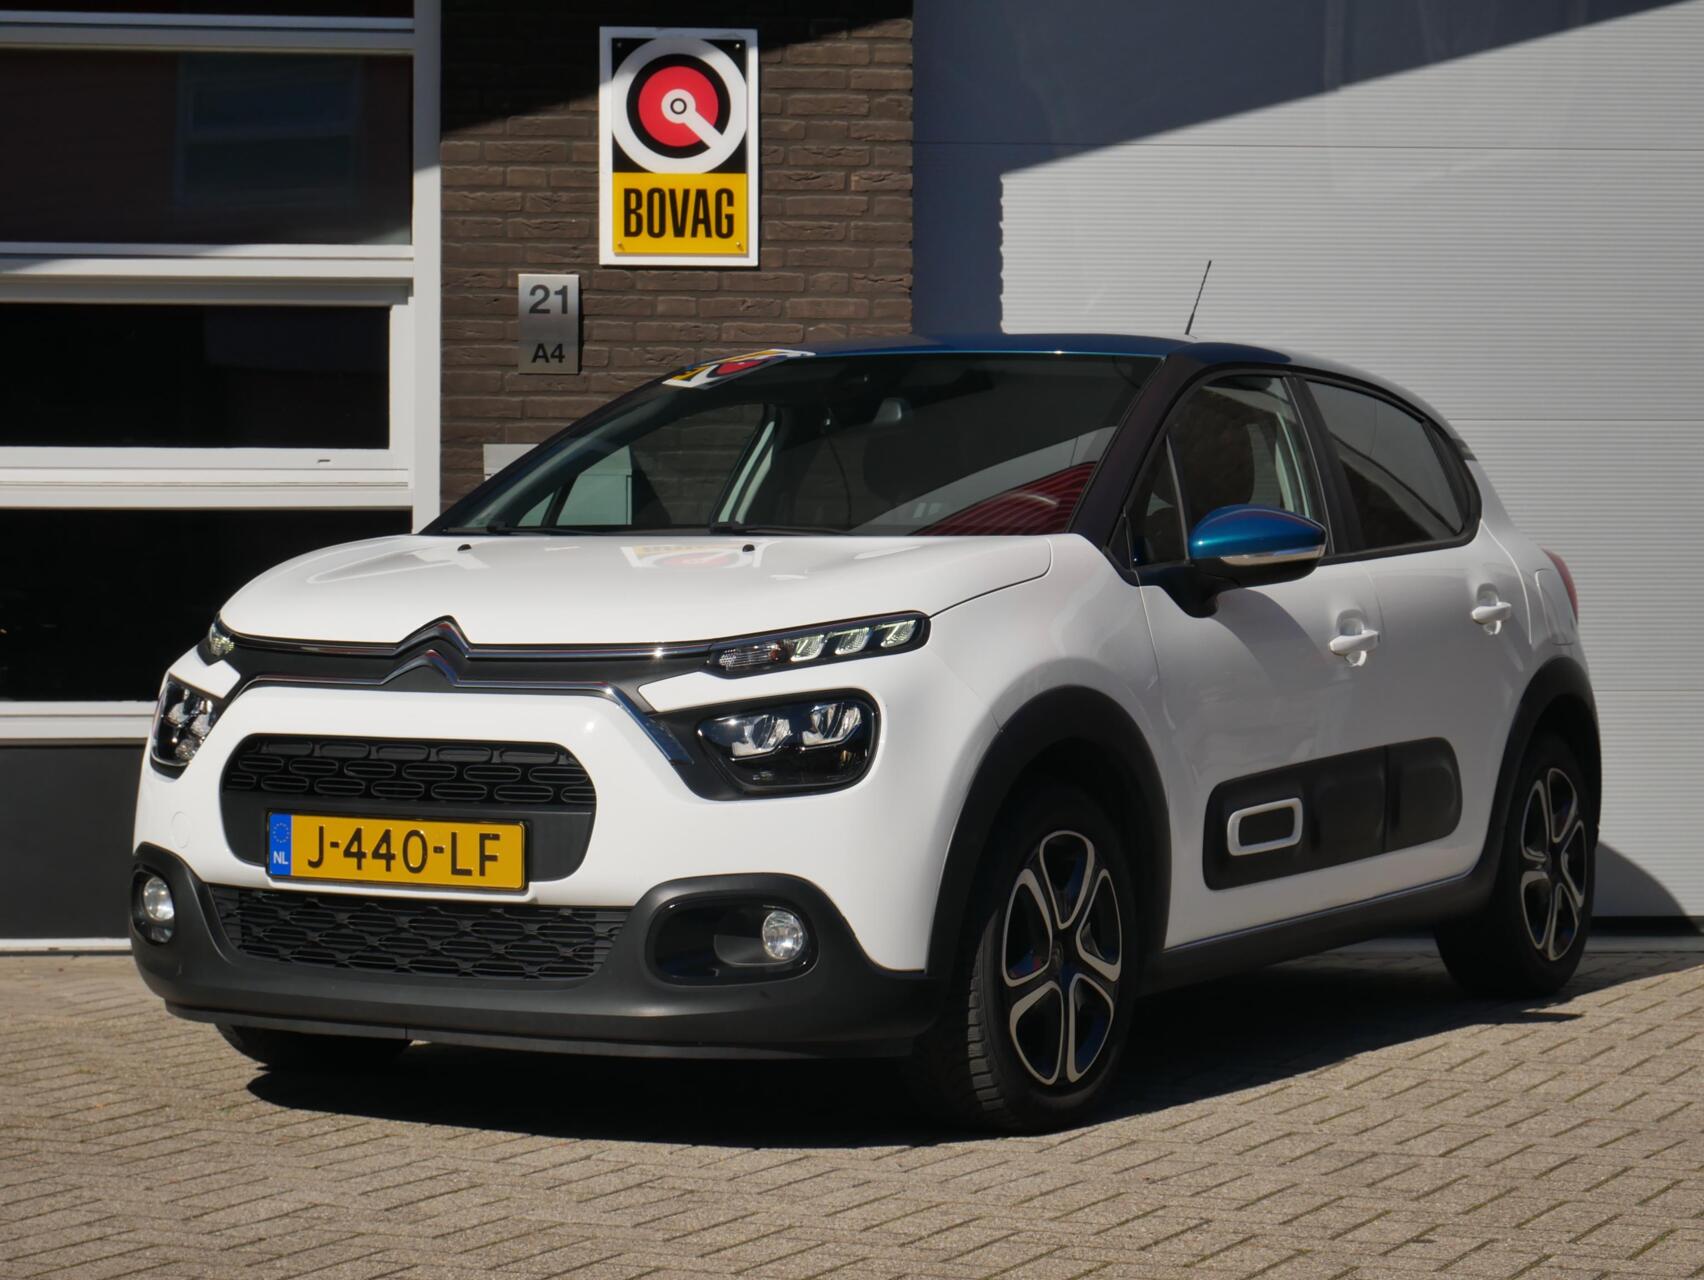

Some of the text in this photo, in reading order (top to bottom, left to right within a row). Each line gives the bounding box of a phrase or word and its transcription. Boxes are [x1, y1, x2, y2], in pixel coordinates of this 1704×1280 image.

[624, 187, 735, 239] BOVAG
[528, 284, 569, 315] 21
[530, 343, 566, 364] A4
[273, 851, 289, 865] NL
[307, 825, 501, 877] J-440-LF
